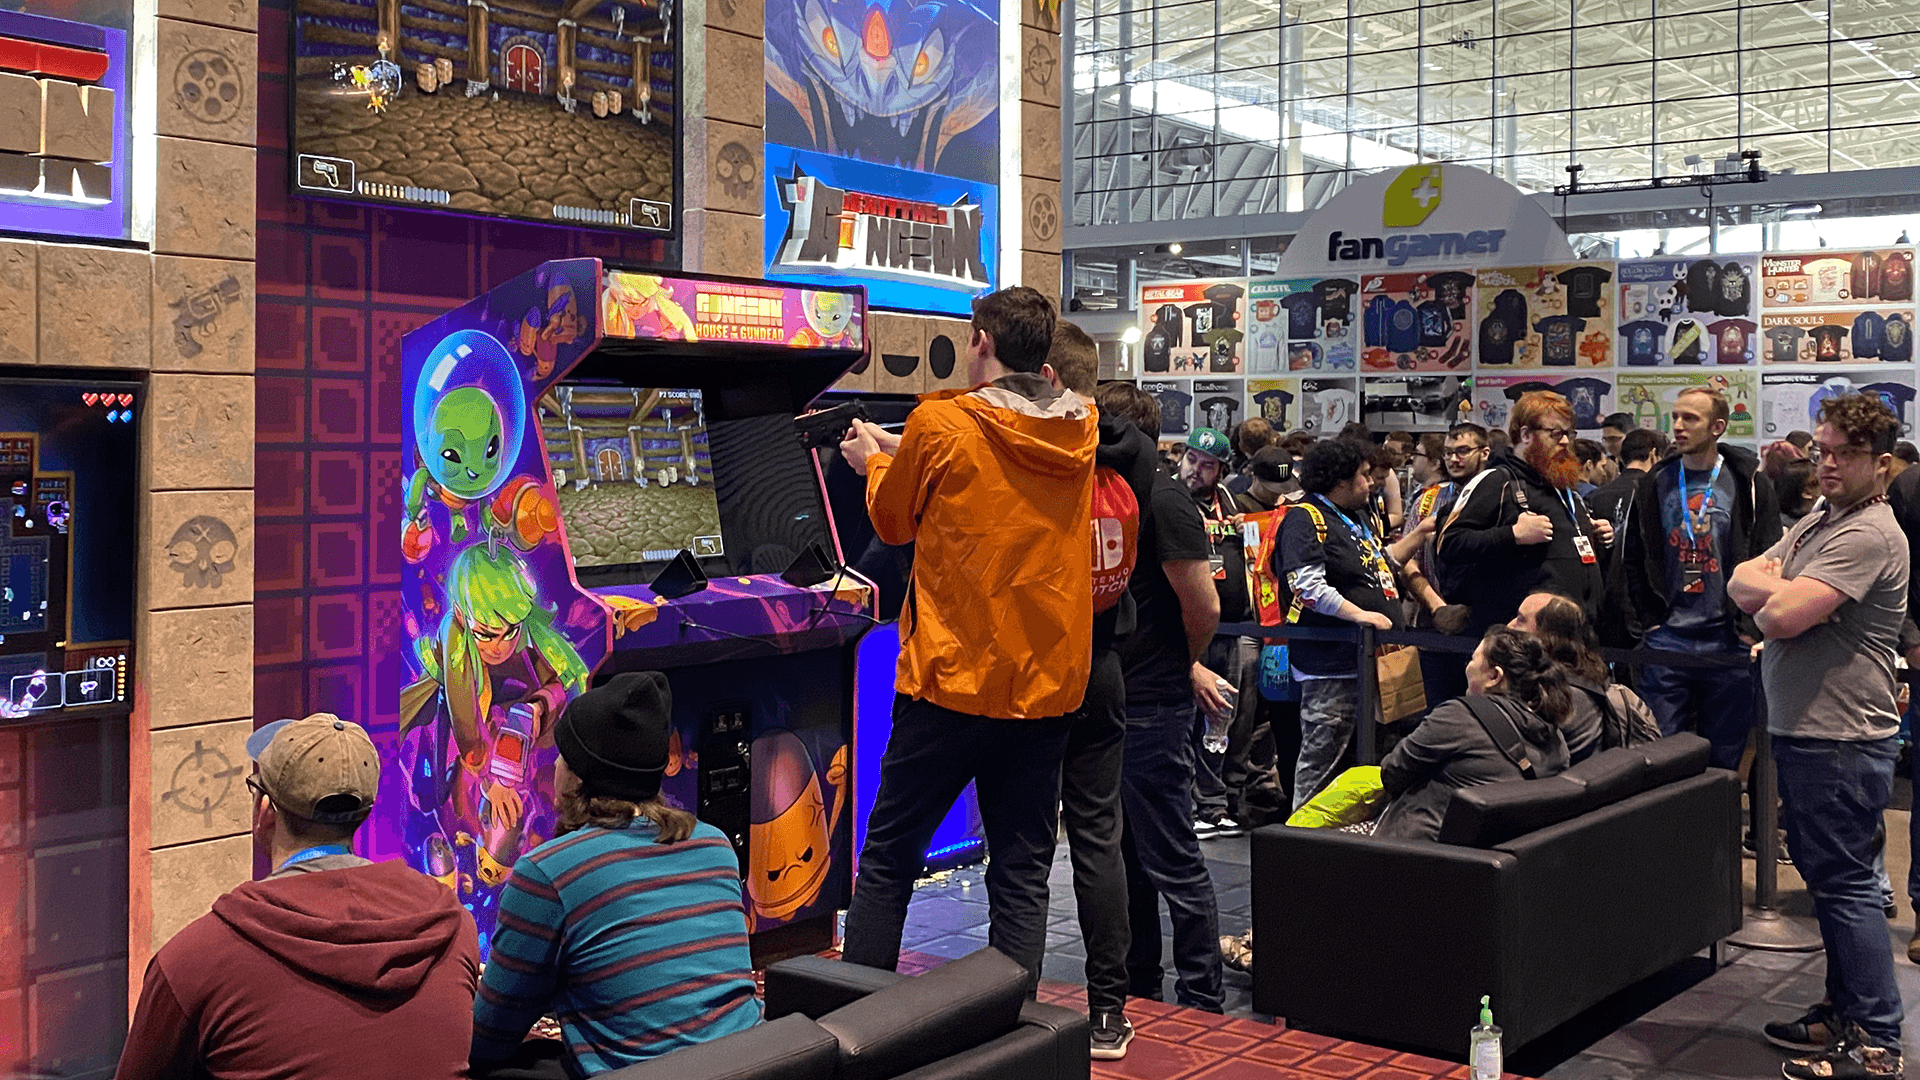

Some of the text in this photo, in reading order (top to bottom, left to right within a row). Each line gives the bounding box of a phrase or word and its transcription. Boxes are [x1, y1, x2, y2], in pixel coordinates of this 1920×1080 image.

[1328, 229, 1506, 267] fangamer
[1763, 258, 1802, 268] MONSTER
[1768, 266, 1800, 276] HUNTER
[1250, 284, 1291, 294] CELESTE
[695, 292, 784, 328] GUNGEON
[1764, 315, 1825, 326] DARK SOULS
[695, 323, 729, 339] HOUSE
[740, 325, 784, 341] GUNDEAD
[1618, 374, 1656, 384] Katamari
